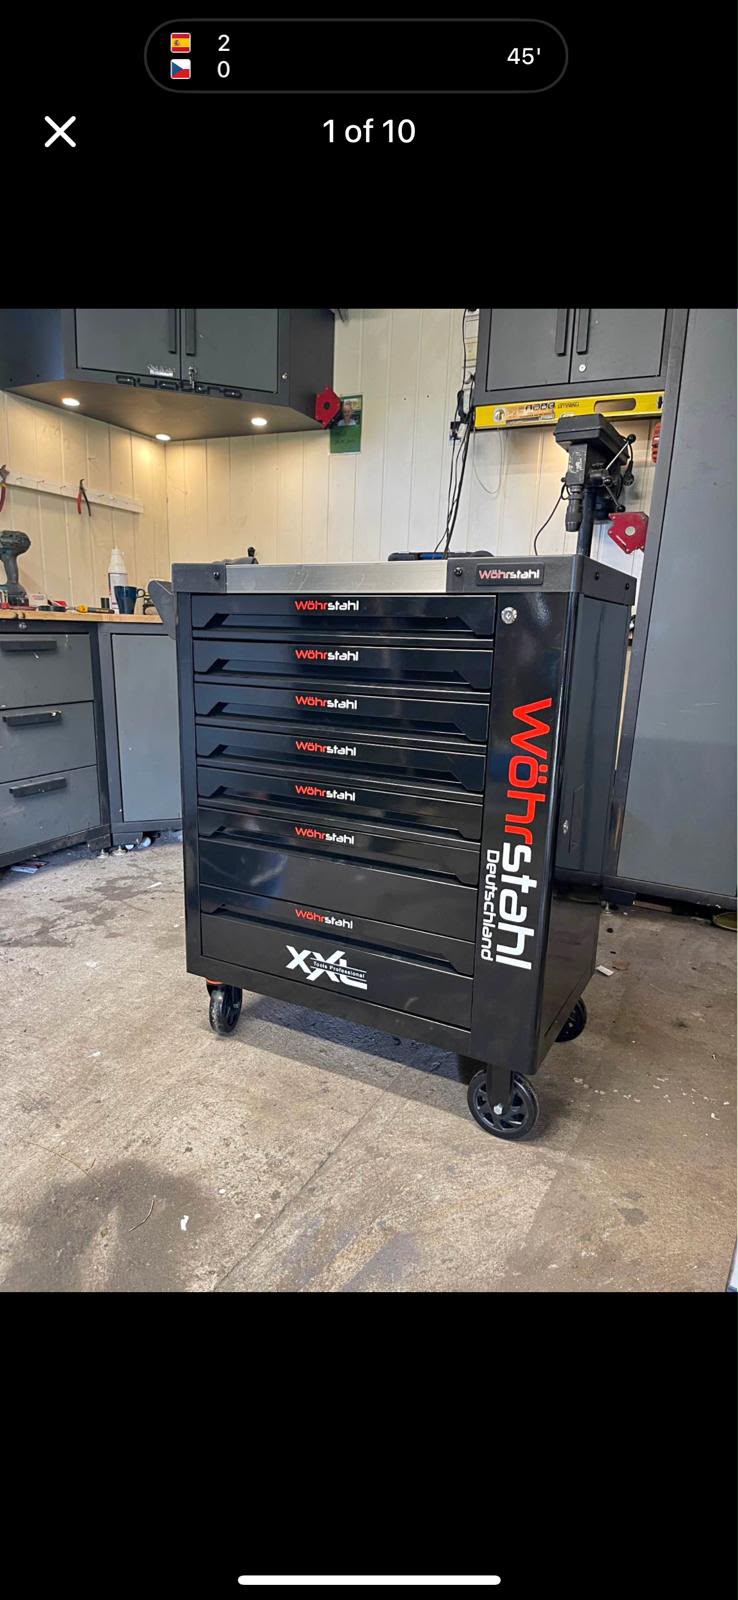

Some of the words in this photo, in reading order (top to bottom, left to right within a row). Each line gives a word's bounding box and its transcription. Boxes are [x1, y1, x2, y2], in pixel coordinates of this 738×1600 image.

[479, 568, 540, 580] Wöhrstahl
[295, 600, 359, 611] Wöhrstahl
[295, 649, 359, 662] Wöhrstahl
[295, 695, 358, 710] Wöhrstahl
[295, 740, 357, 757] Wöhrstahl
[295, 784, 356, 802] Wöhrstahl
[295, 827, 355, 845] Wöhrstahl
[495, 697, 553, 970] Wöhrstahl
[480, 849, 500, 962] Deutschland
[295, 909, 354, 930] Wöhrstahl
[286, 945, 368, 990] XXL
[313, 961, 328, 970] Tools
[329, 965, 365, 979] Professional
